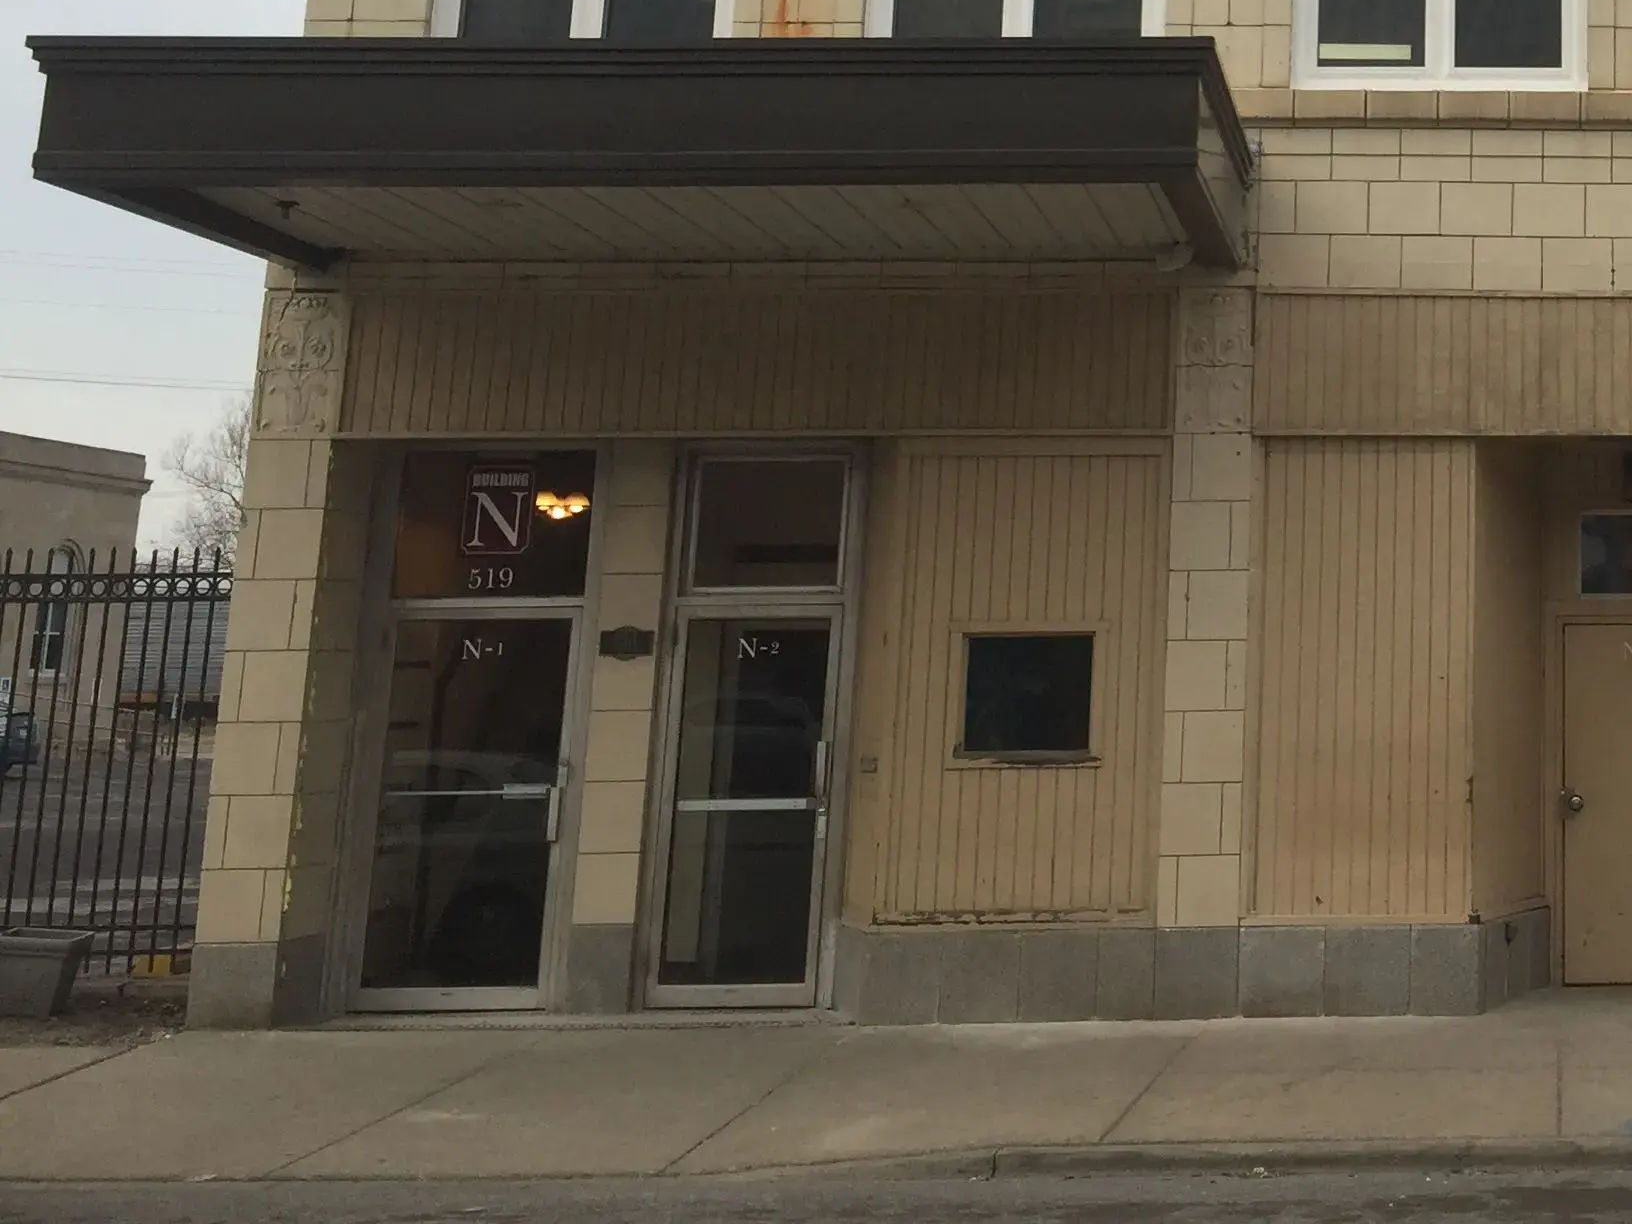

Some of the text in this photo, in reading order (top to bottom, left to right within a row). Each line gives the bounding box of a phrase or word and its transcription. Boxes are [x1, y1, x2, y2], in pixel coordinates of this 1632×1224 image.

[472, 472, 530, 487] BUILDING
[466, 491, 529, 547] N
[468, 567, 514, 589] 519
[461, 638, 503, 660] N-1
[736, 636, 780, 658] N-2
